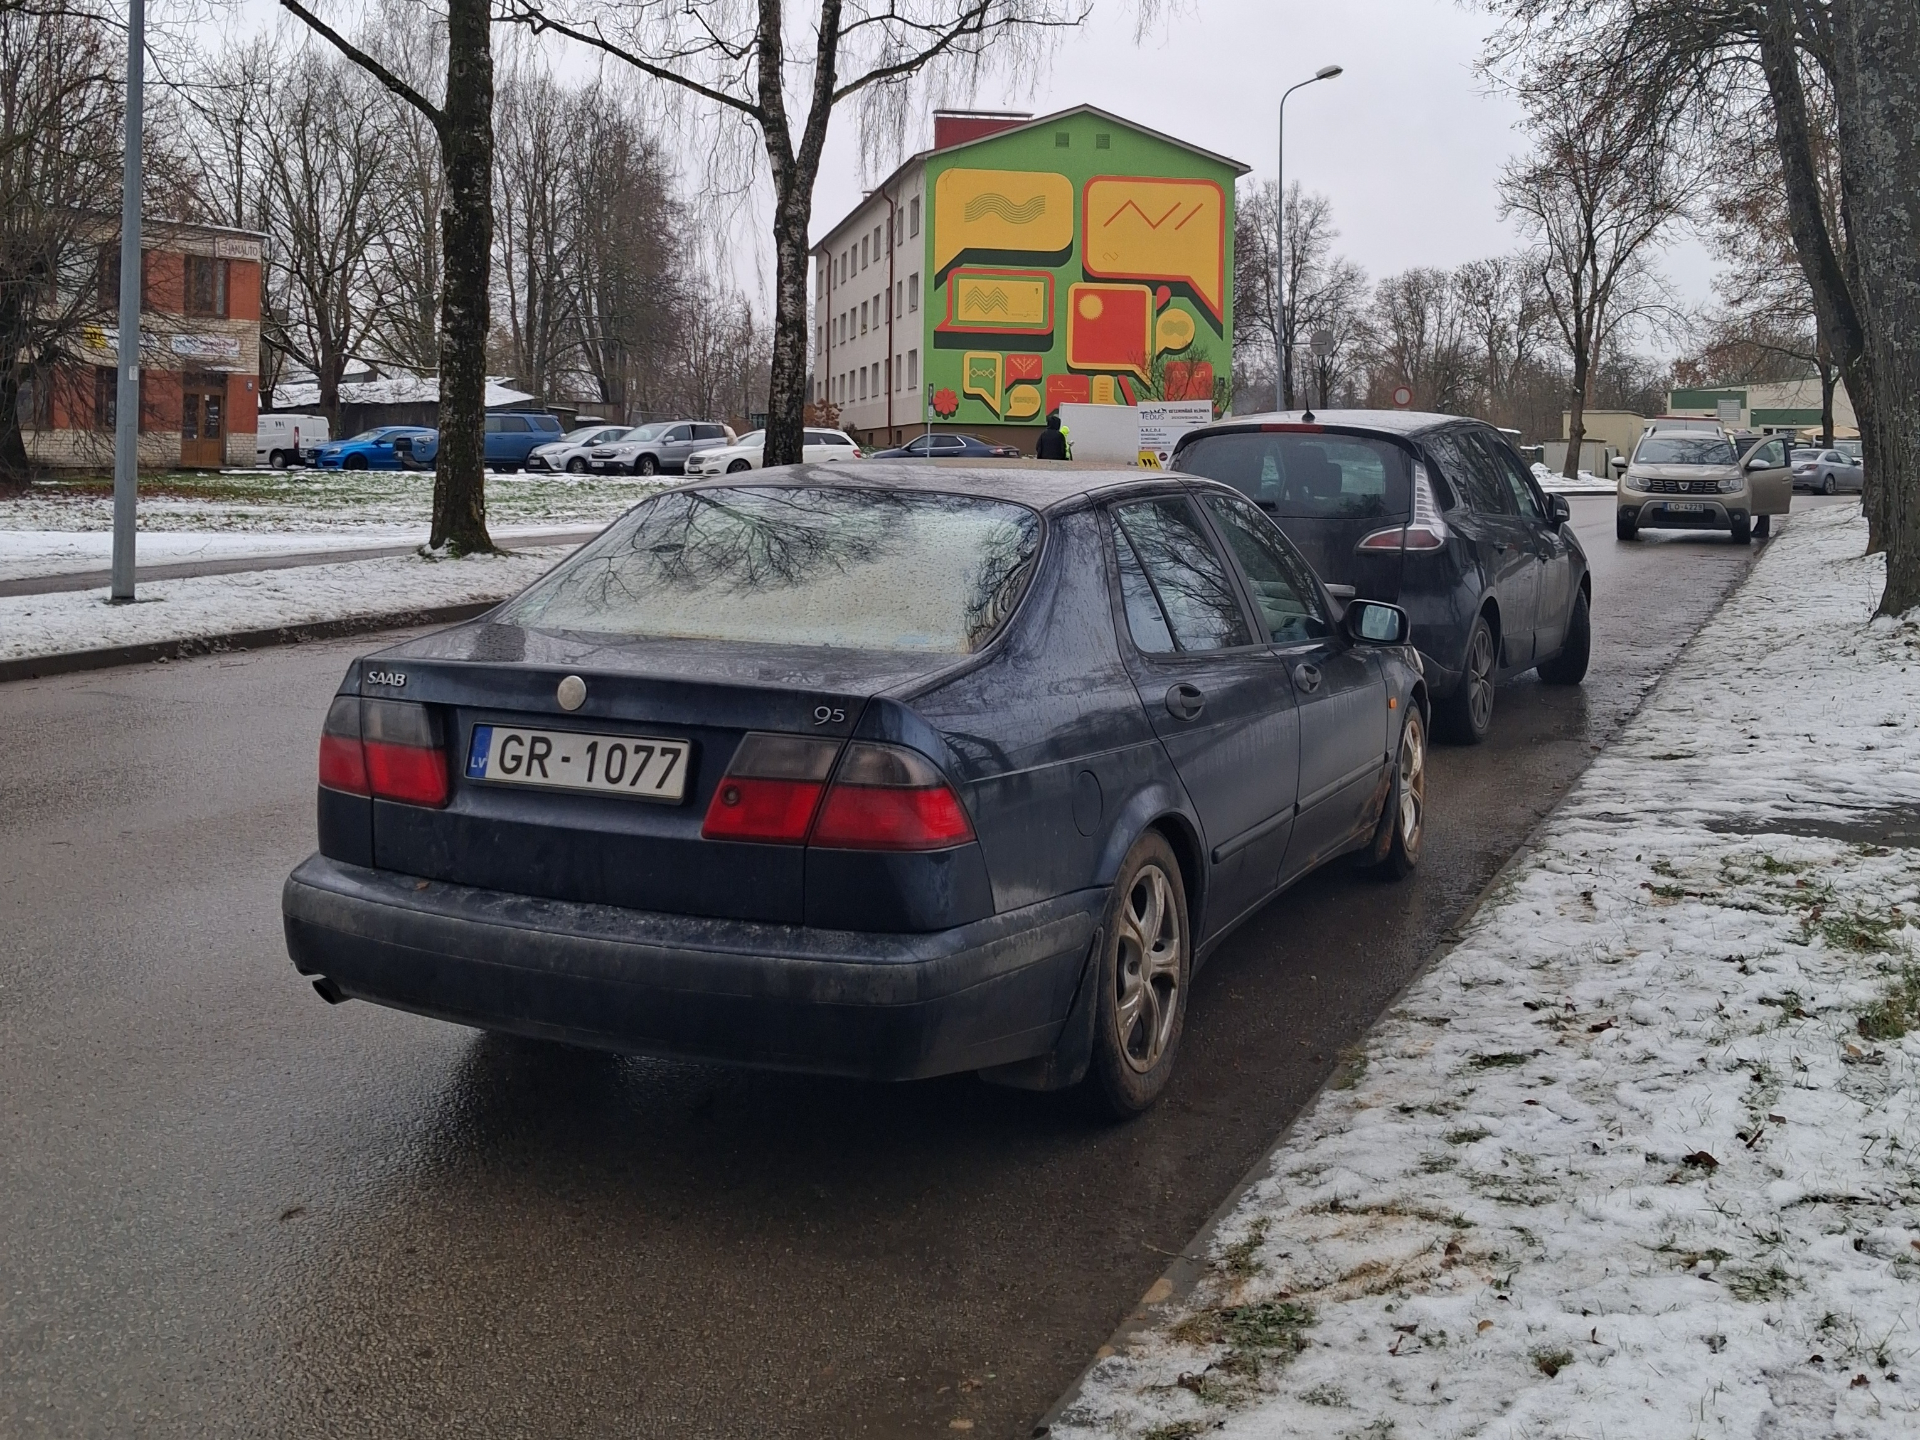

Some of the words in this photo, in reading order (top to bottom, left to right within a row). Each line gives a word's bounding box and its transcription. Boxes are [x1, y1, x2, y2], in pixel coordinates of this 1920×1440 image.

[1139, 410, 1165, 420] TEDUS
[367, 671, 406, 687] SAAB
[814, 706, 845, 726] 95
[470, 756, 486, 769] LV
[499, 734, 682, 789] GR-1077
